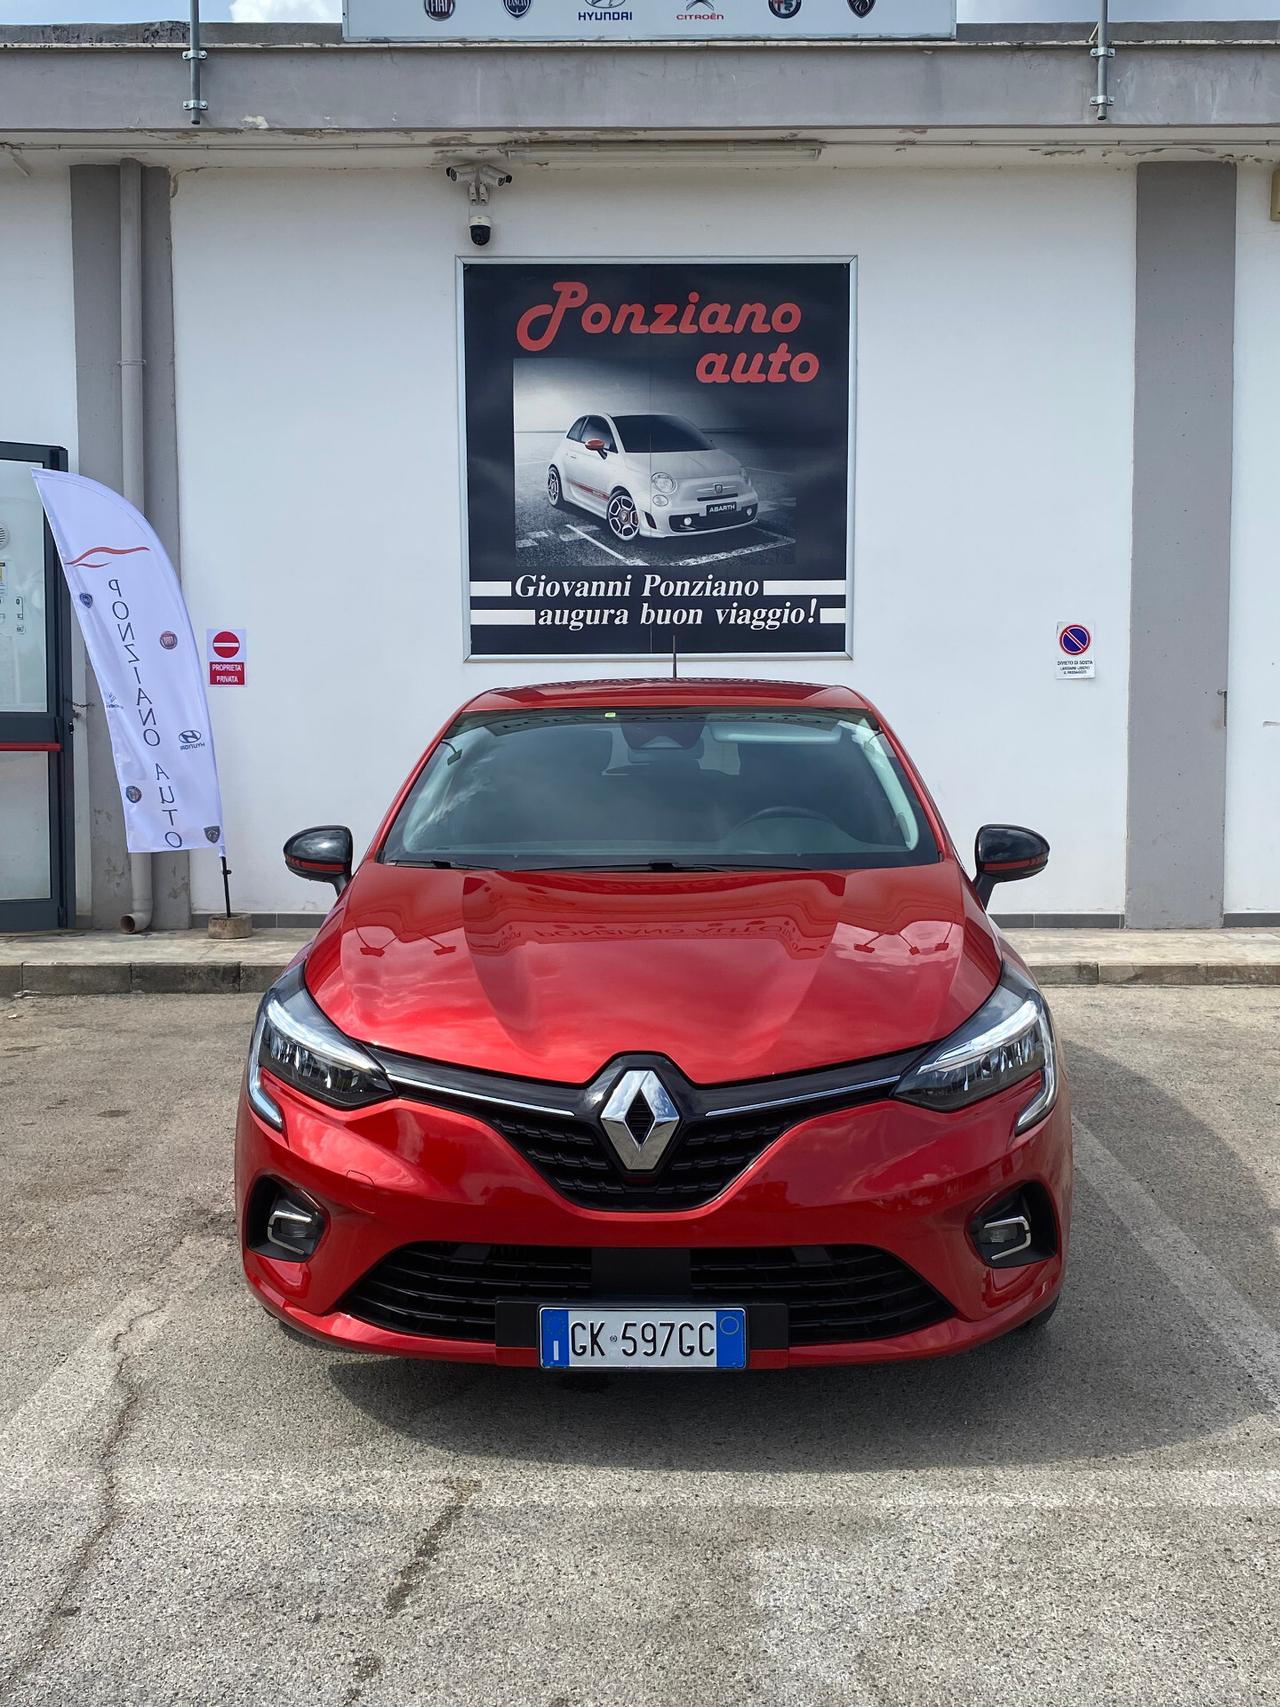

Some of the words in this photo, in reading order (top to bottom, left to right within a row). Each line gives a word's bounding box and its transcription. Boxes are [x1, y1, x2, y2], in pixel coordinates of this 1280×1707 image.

[578, 11, 633, 21] HYUNDAI
[676, 12, 725, 20] CITROËN
[515, 281, 802, 352] Ponziano
[695, 342, 820, 384] auto
[708, 504, 736, 514] ABARTH
[515, 573, 632, 599] Giovanni
[641, 573, 760, 599] Ponziano
[538, 606, 629, 631] augura
[640, 603, 704, 626] buon
[716, 598, 818, 632] viaggio!
[216, 675, 239, 683] PRIVATA
[570, 1322, 606, 1357] GK
[621, 1322, 715, 1357] 597GC
